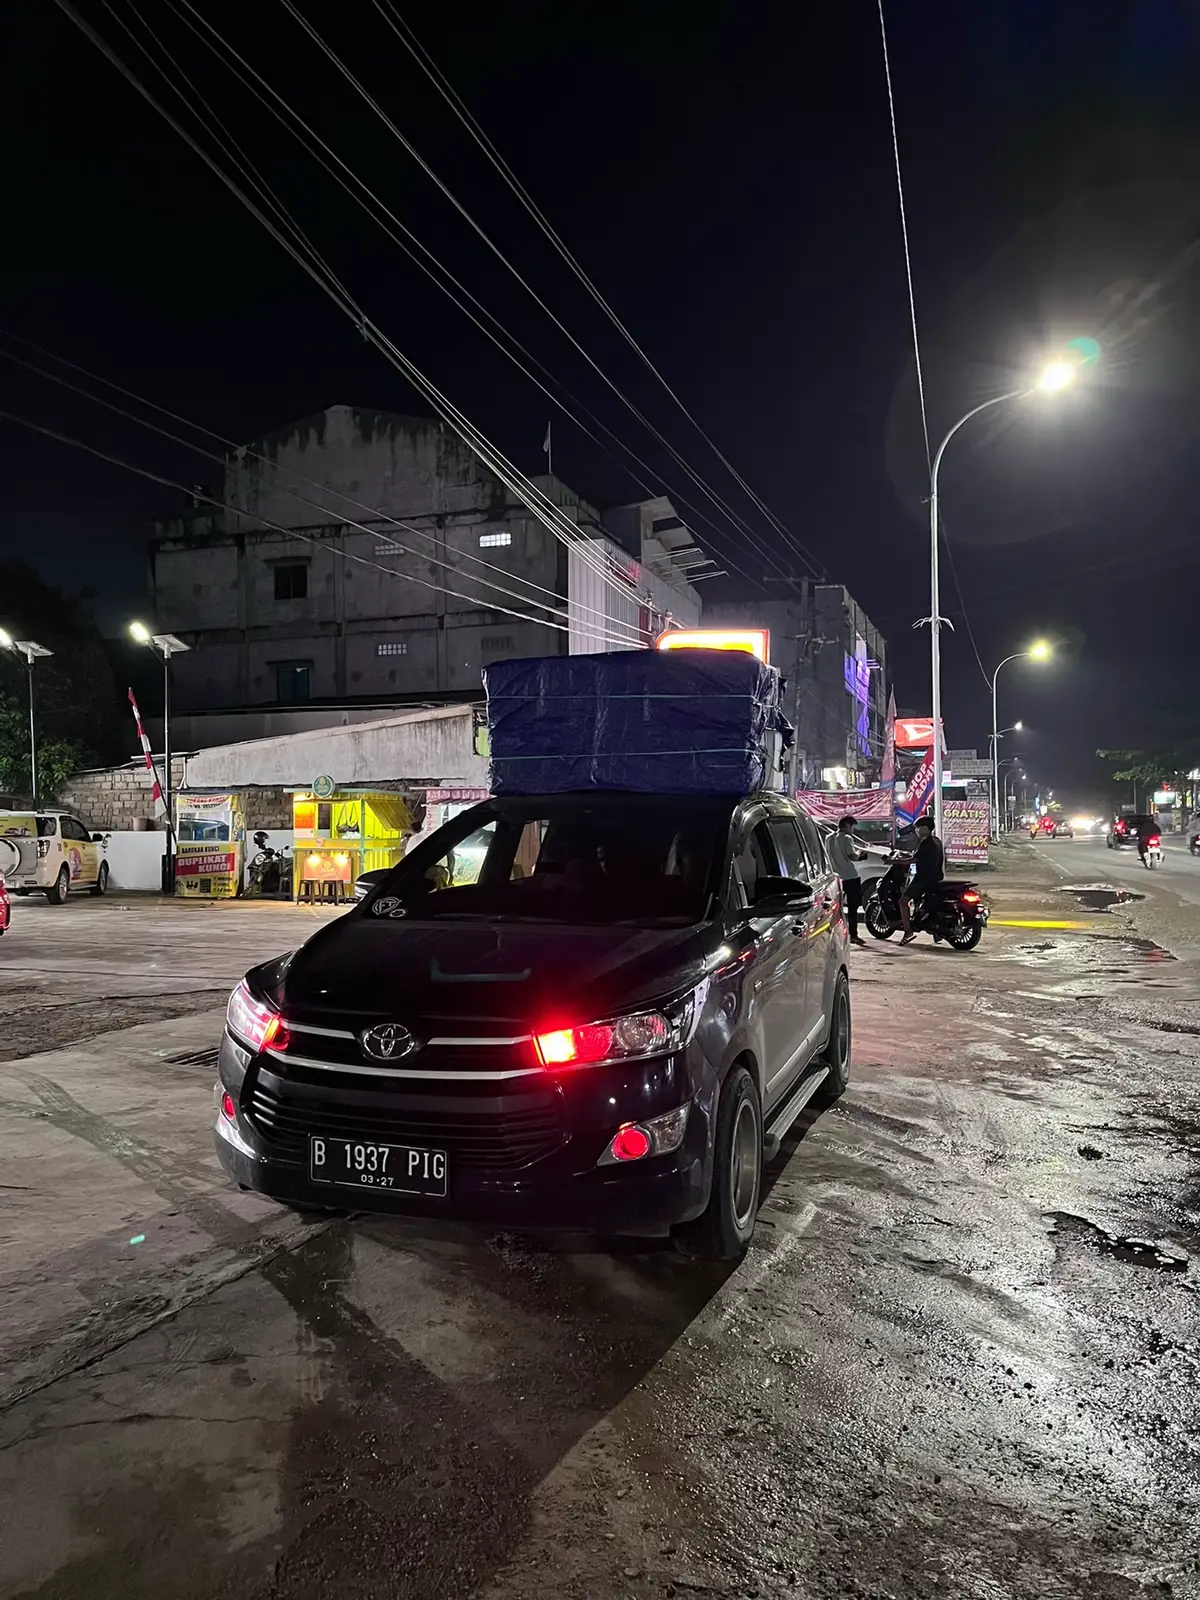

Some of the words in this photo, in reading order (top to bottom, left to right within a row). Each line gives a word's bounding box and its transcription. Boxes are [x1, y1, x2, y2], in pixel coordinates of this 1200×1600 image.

[906, 763, 927, 801] SHOP
[943, 809, 986, 819] GRATIS
[965, 835, 988, 848] 40%
[178, 855, 227, 867] DUPLIKAT
[198, 863, 231, 873] KUNCI
[314, 1140, 326, 1166] B
[344, 1143, 390, 1173] 1937
[408, 1150, 444, 1179] PIG
